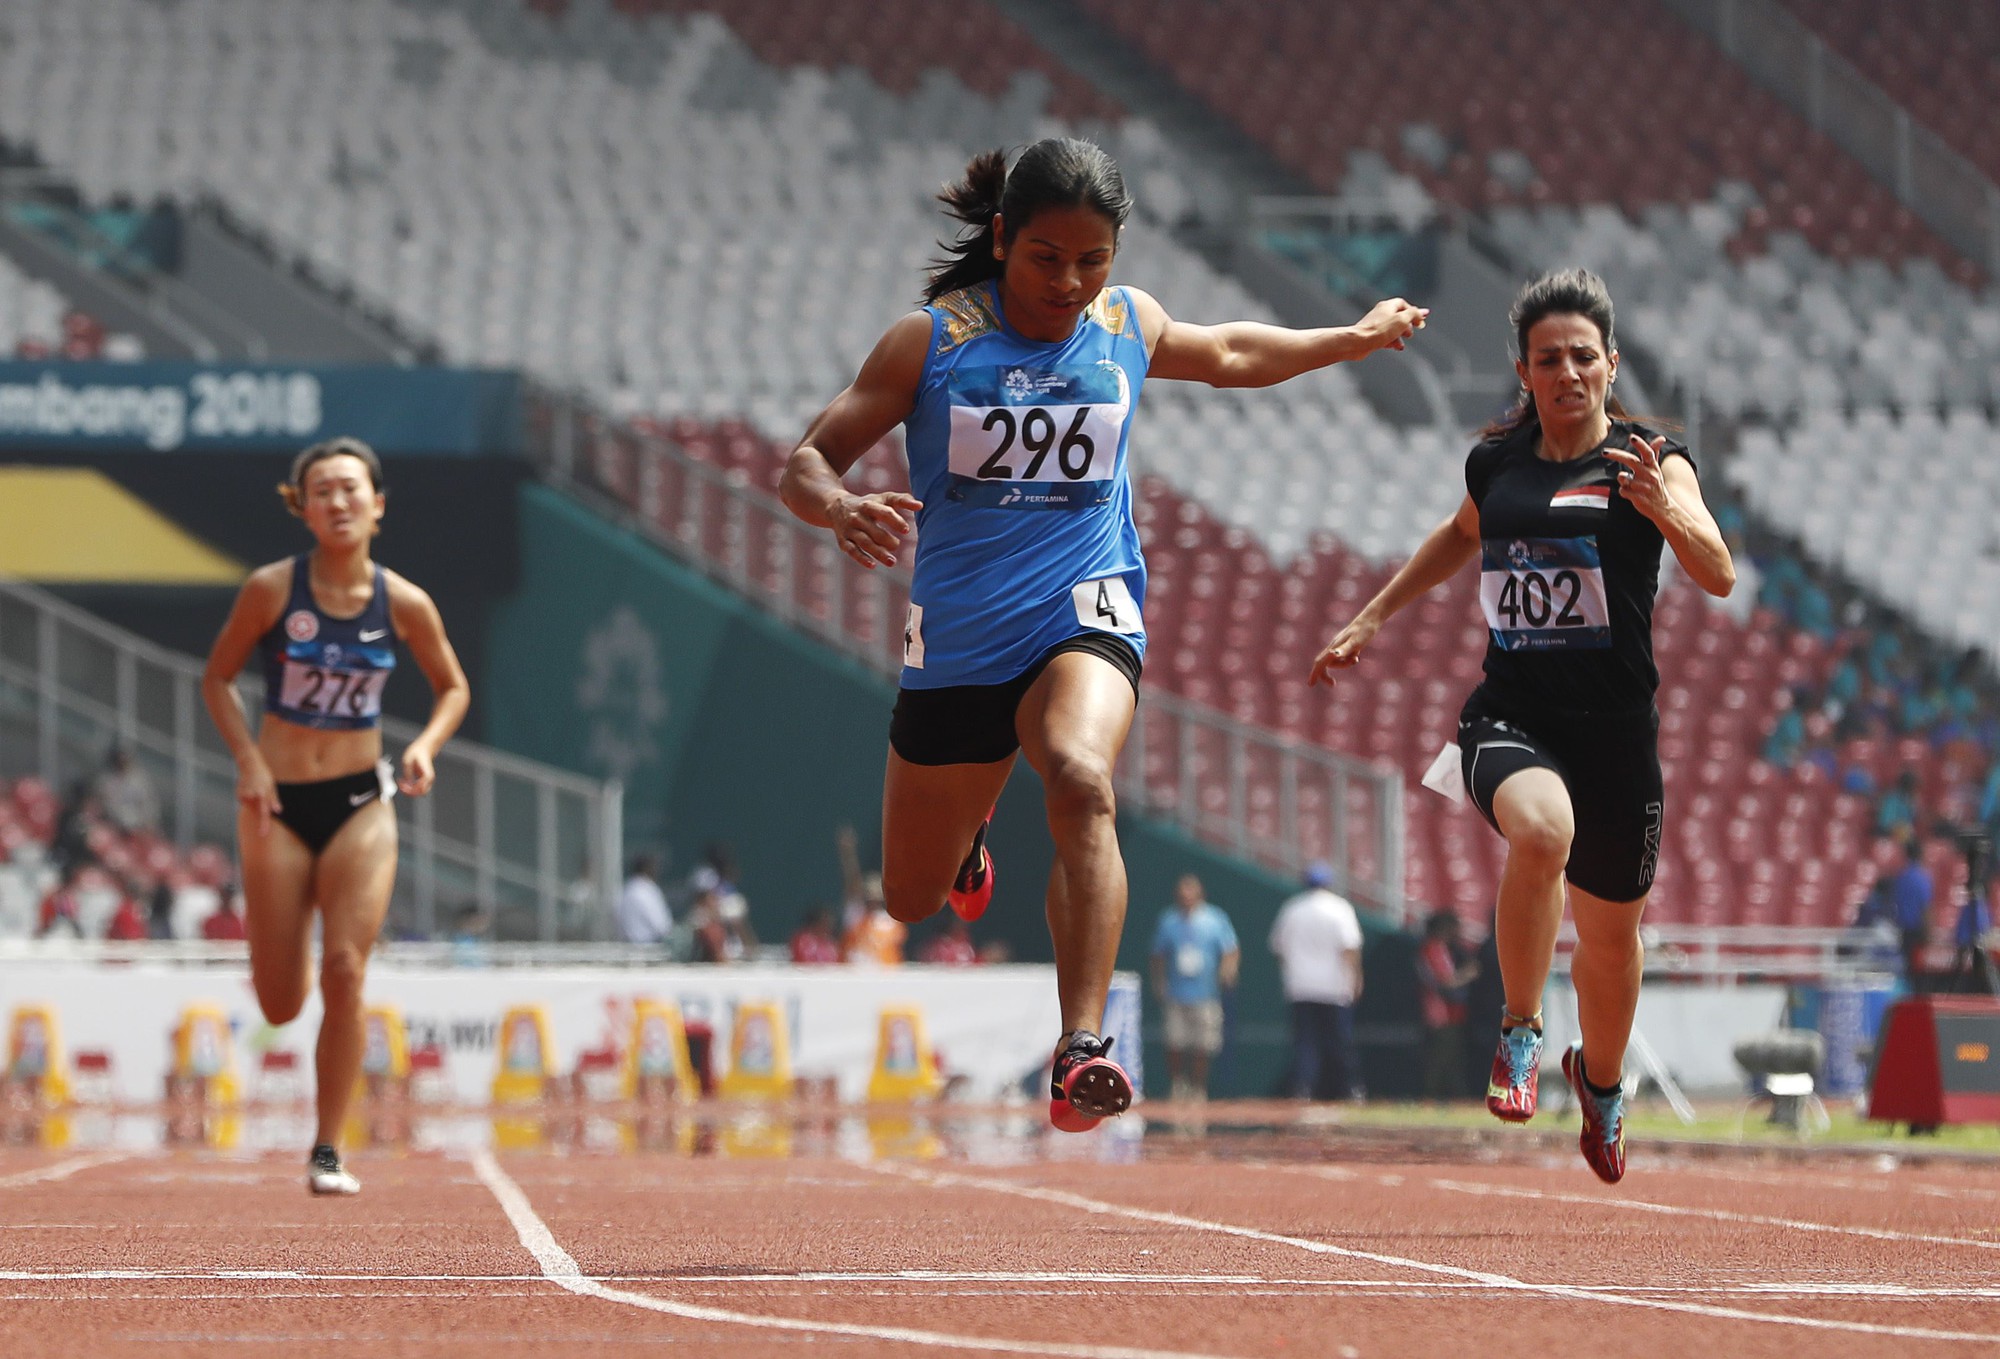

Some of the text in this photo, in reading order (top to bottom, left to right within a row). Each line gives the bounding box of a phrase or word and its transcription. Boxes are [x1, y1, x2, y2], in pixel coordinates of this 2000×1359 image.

[191, 372, 321, 435] 2018
[977, 408, 1094, 479] 296
[1096, 581, 1118, 626] 4
[1498, 571, 1584, 628] 402
[300, 670, 369, 716] 276
[1639, 801, 1661, 886] 2XU
